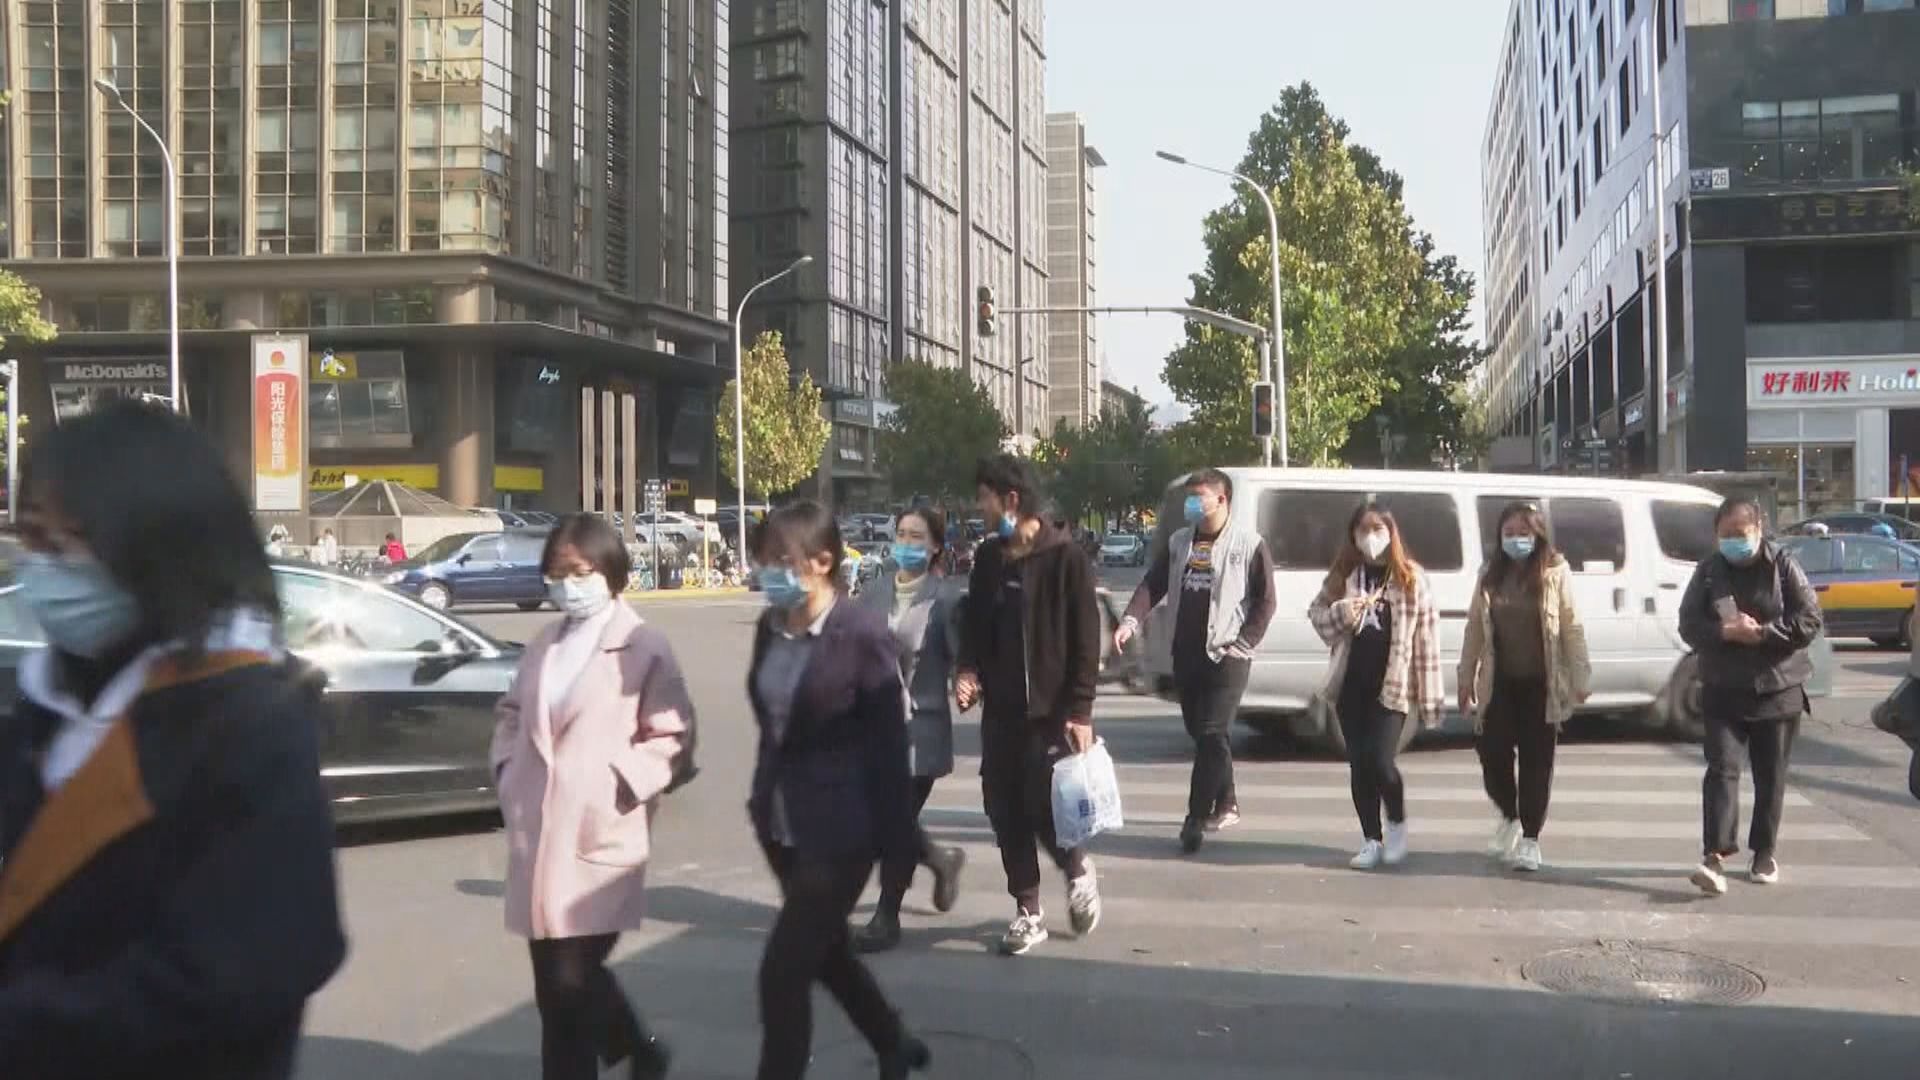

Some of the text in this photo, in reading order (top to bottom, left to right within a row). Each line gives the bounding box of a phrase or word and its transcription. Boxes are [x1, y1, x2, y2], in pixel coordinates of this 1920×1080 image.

[65, 364, 167, 379] McDonald's
[1762, 371, 1851, 395] 好利来
